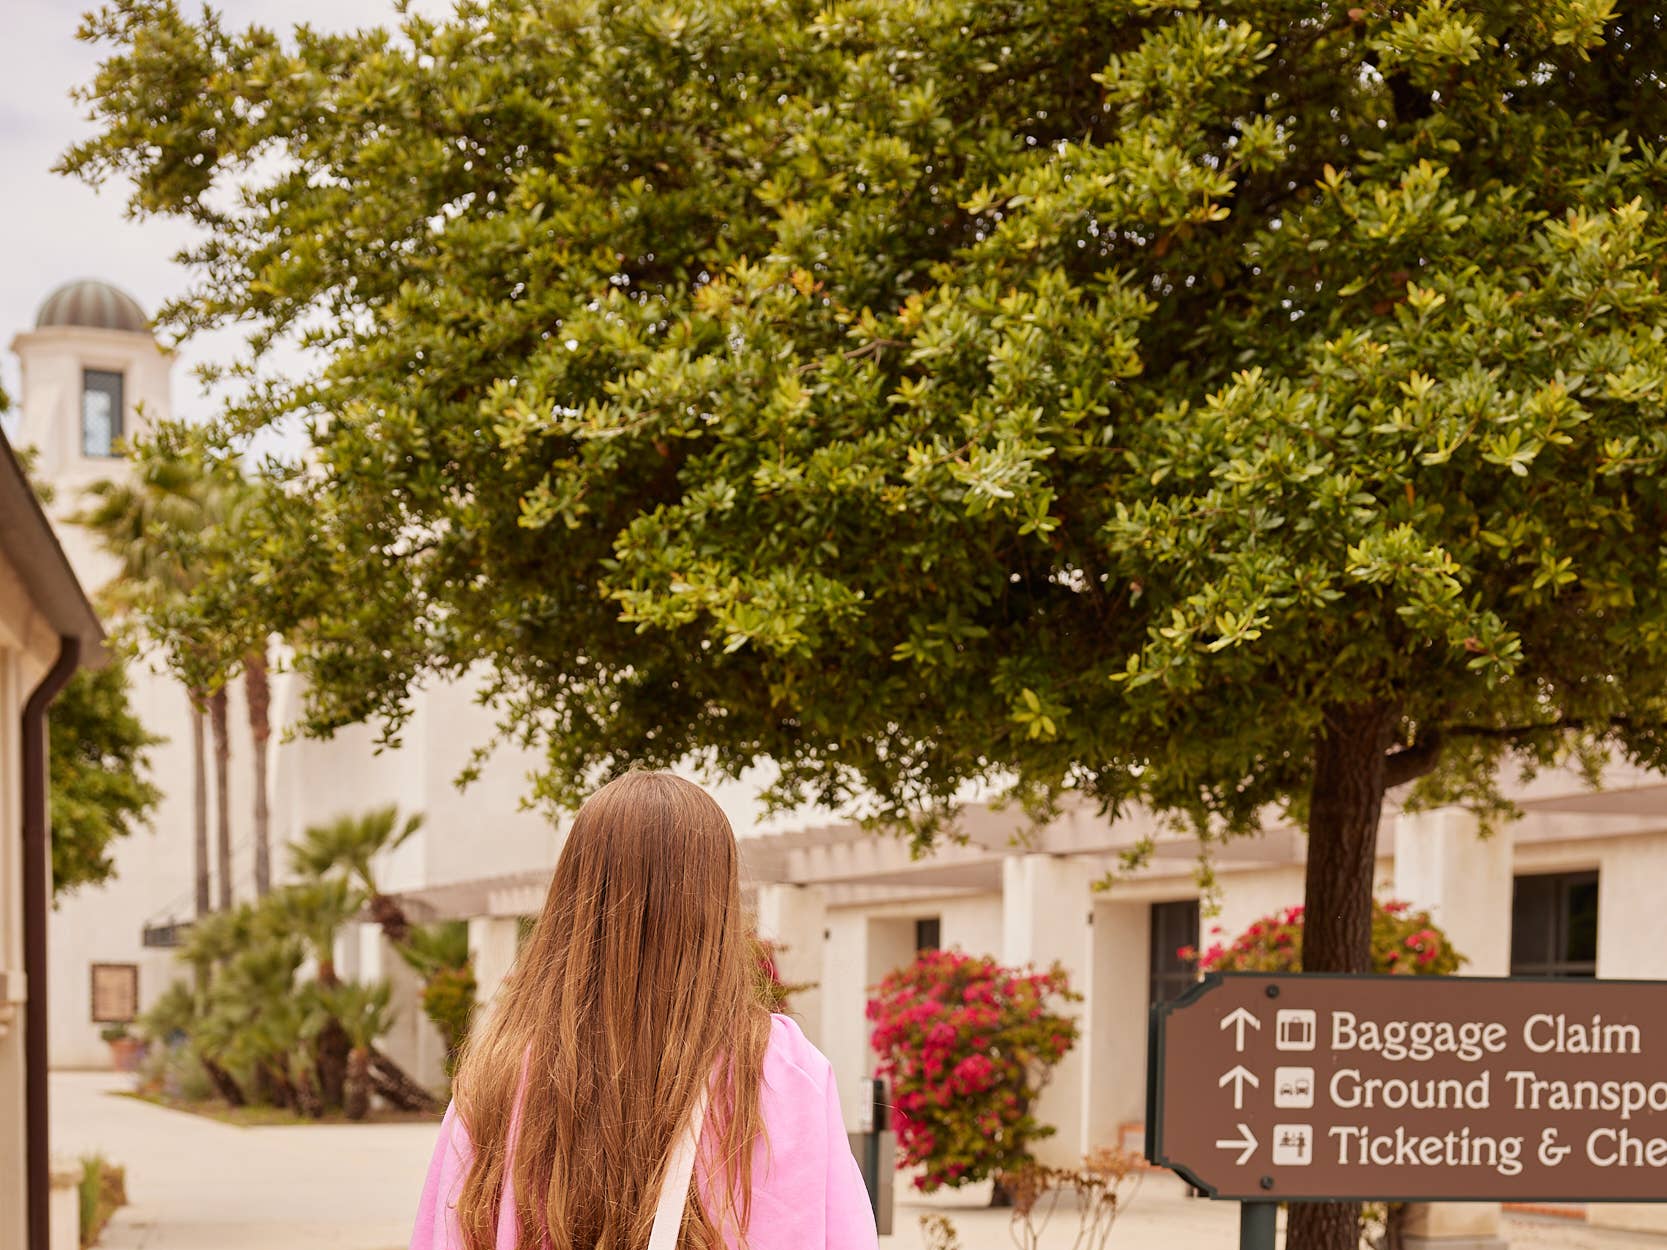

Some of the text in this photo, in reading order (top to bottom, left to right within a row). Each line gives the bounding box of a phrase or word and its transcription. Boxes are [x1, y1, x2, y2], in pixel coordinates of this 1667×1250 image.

[1331, 1011, 1641, 1062] Baggage Claim
[1329, 1068, 1667, 1120] Ground Transpo
[1328, 1126, 1667, 1176] Ticketing & Che
